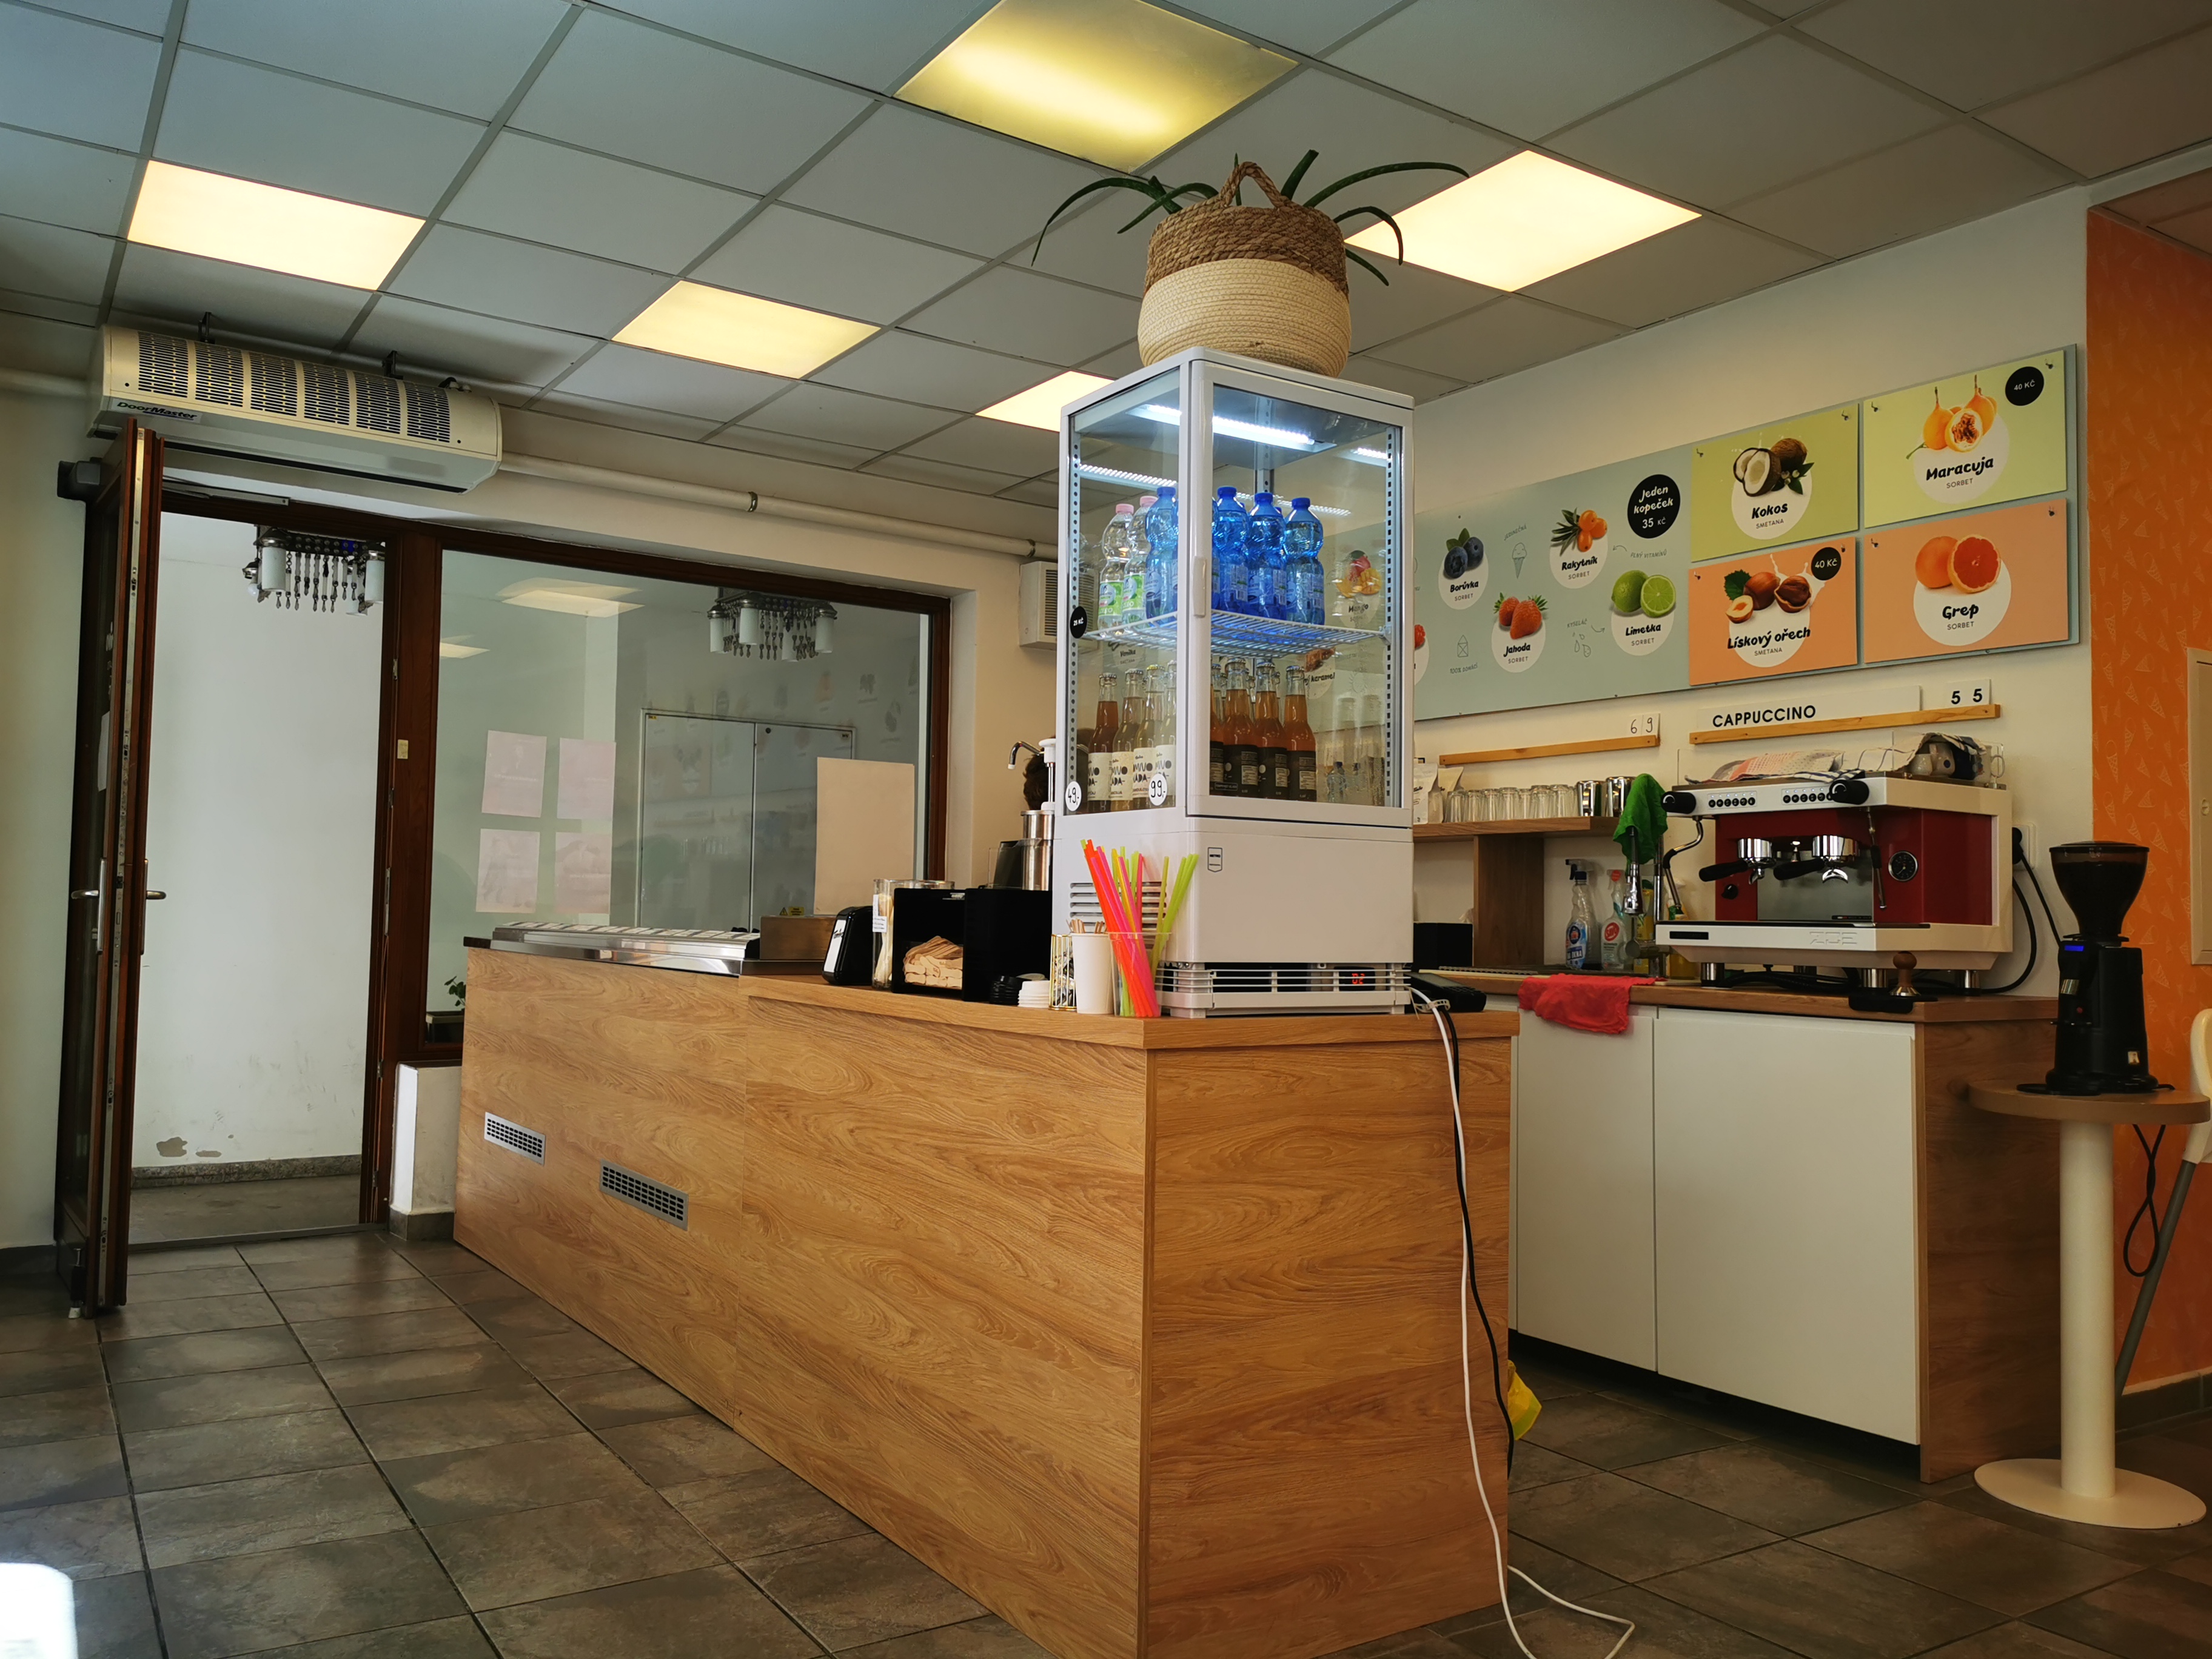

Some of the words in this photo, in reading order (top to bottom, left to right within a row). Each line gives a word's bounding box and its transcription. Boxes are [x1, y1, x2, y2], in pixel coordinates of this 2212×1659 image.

[117, 401, 198, 420] DoorMaster
[1926, 457, 1994, 481] Maracuja
[1946, 478, 1974, 489] SORBET
[1639, 486, 1669, 503] Jeden
[1634, 497, 1674, 515] kopeček
[1751, 503, 1788, 520] Kokos
[1642, 517, 1654, 529] 35
[1755, 518, 1785, 529] SMETANA
[1561, 556, 1598, 571] Rakytník
[1815, 560, 1825, 569] 40
[1568, 571, 1590, 580] SORBET
[1454, 593, 1474, 602] SORBET
[1942, 604, 1979, 620] Grep
[1625, 624, 1661, 636] Limetka
[1947, 621, 1974, 630] SORBET
[1631, 638, 1655, 646] SORBET
[1728, 631, 1771, 649] Lískový
[1774, 626, 1811, 642] ořech
[1503, 643, 1531, 657] Jahoda
[1754, 647, 1783, 657] SMETANA
[1712, 705, 1816, 728] CAPPUCCINO
